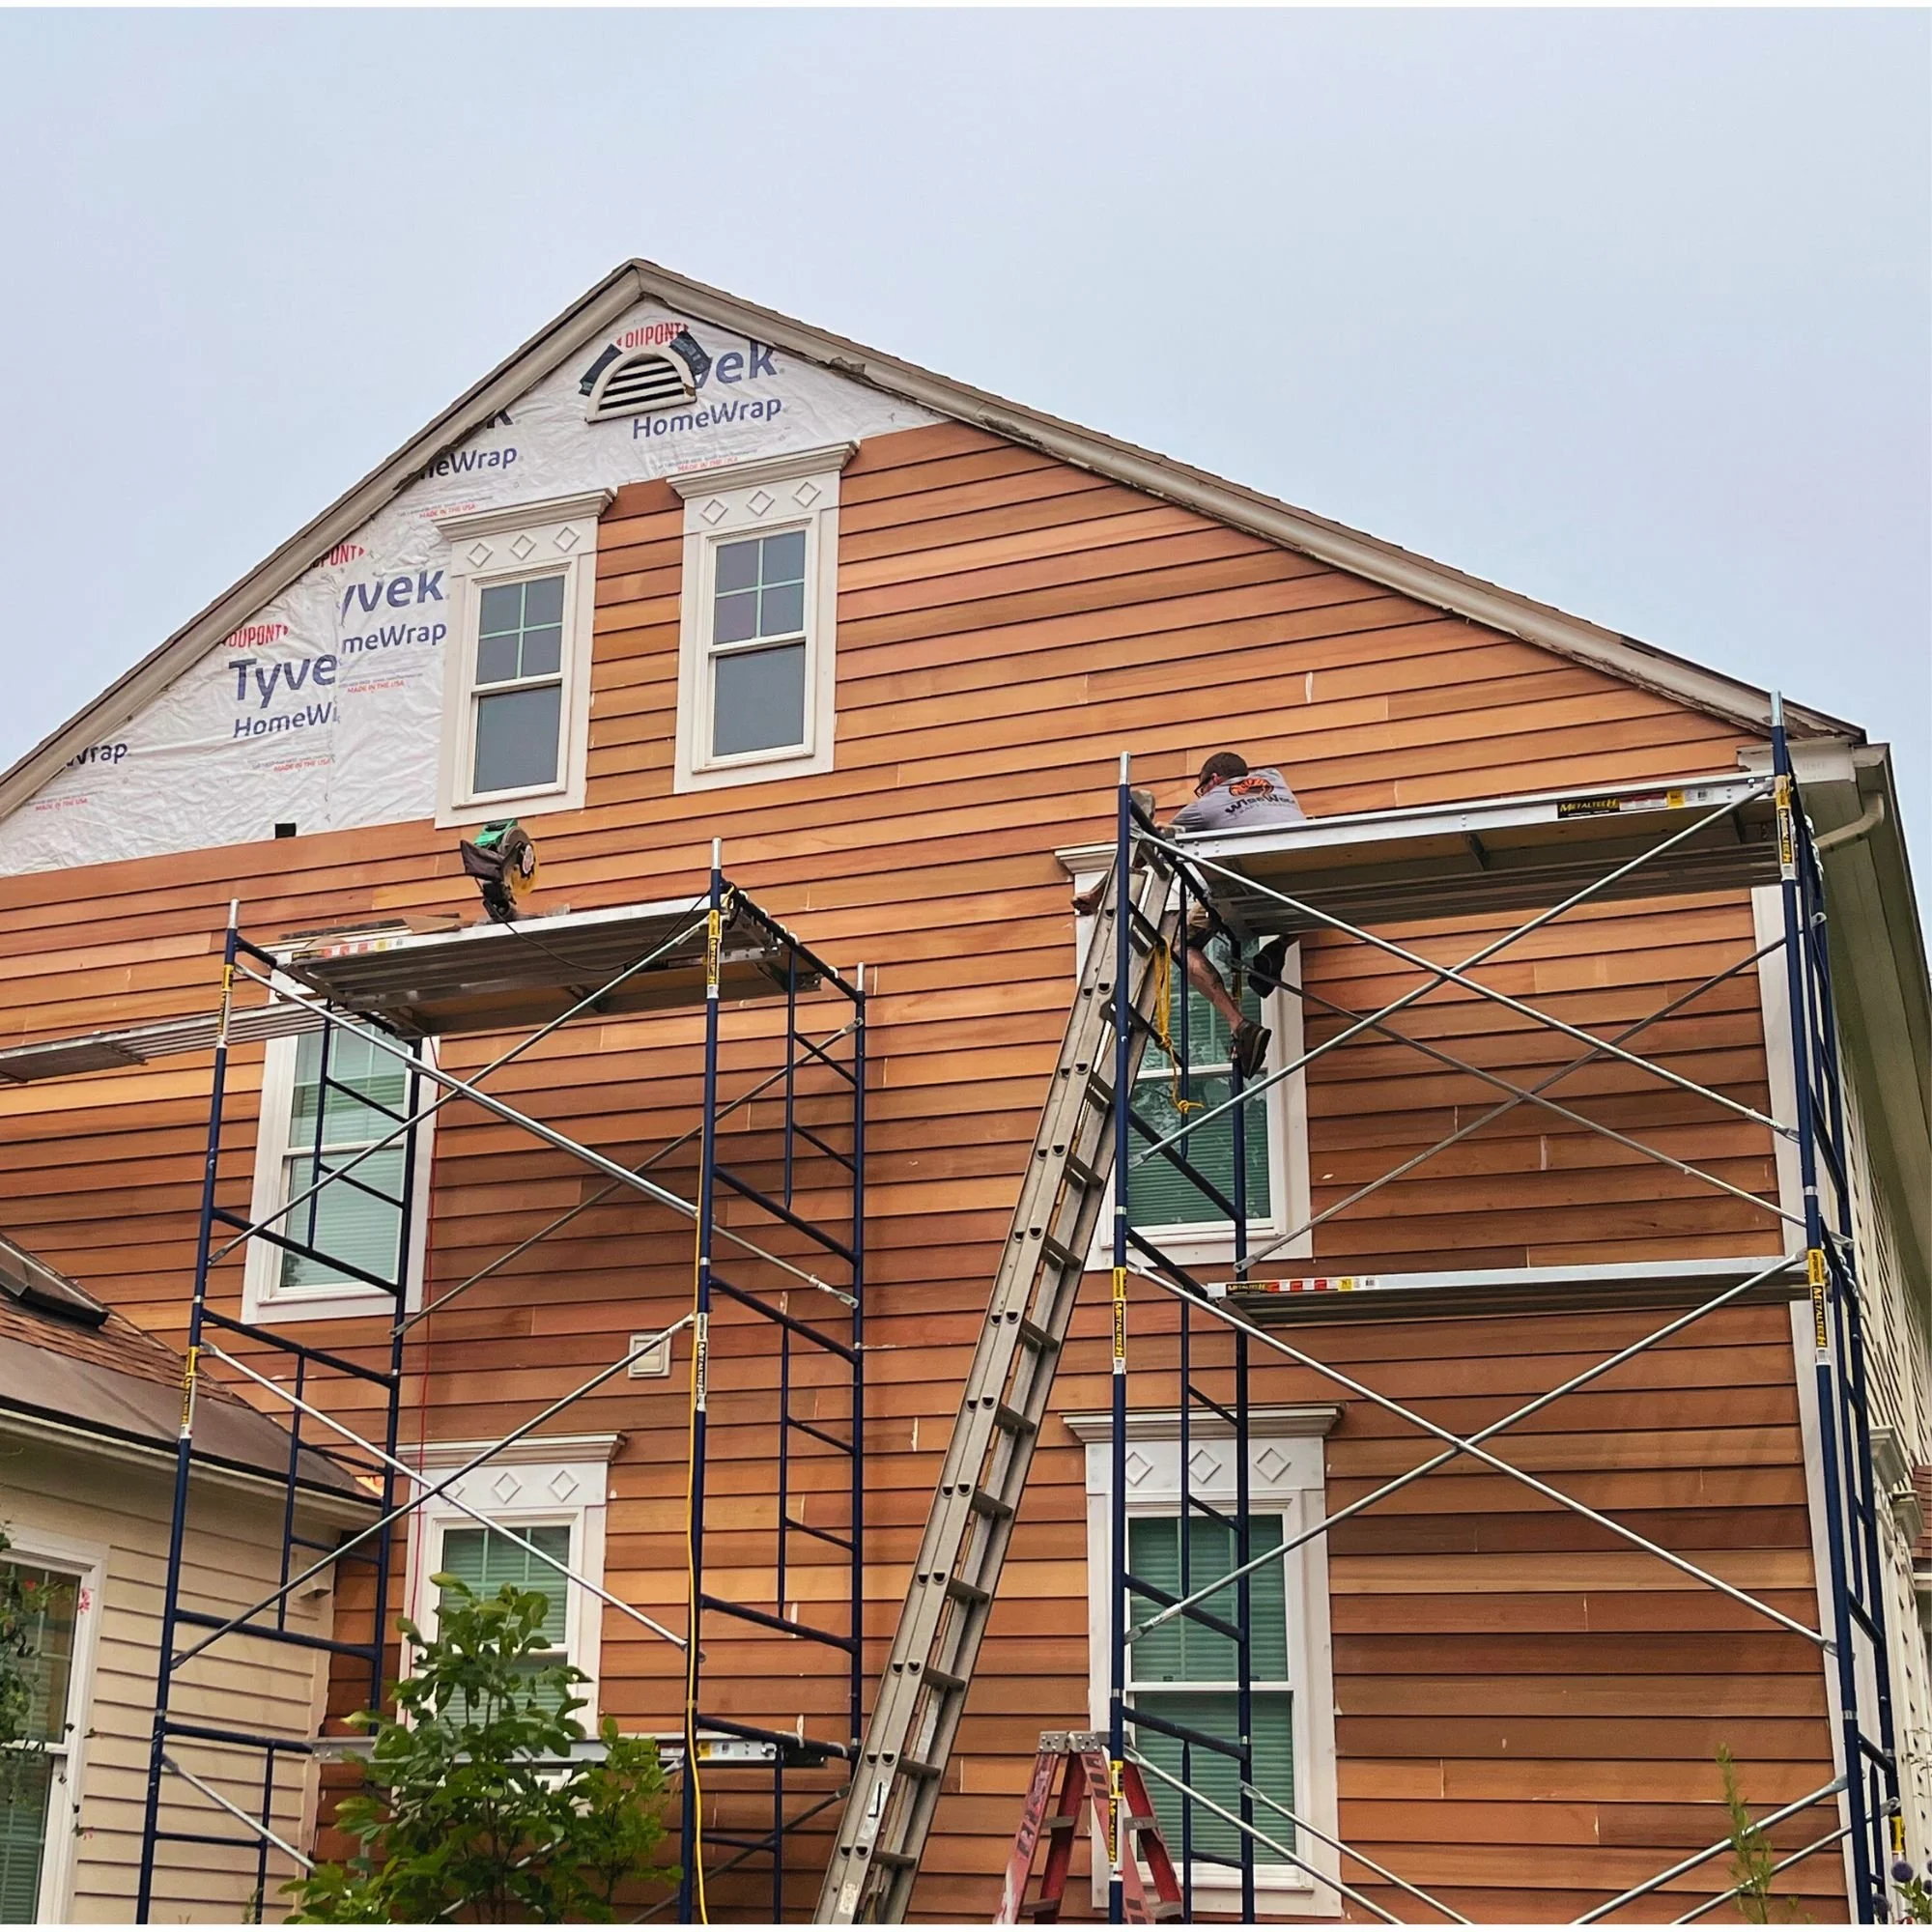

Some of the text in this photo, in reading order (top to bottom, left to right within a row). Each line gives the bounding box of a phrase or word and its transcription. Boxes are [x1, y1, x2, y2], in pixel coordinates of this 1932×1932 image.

[625, 323, 682, 348] DUPONT
[633, 398, 781, 440] HomeWrap
[229, 624, 282, 648] DUPONT
[342, 623, 447, 654] meWrap
[229, 654, 337, 709] Tyve
[1115, 1302, 1123, 1355] METALTECH
[1813, 1287, 1826, 1346] METALTECH
